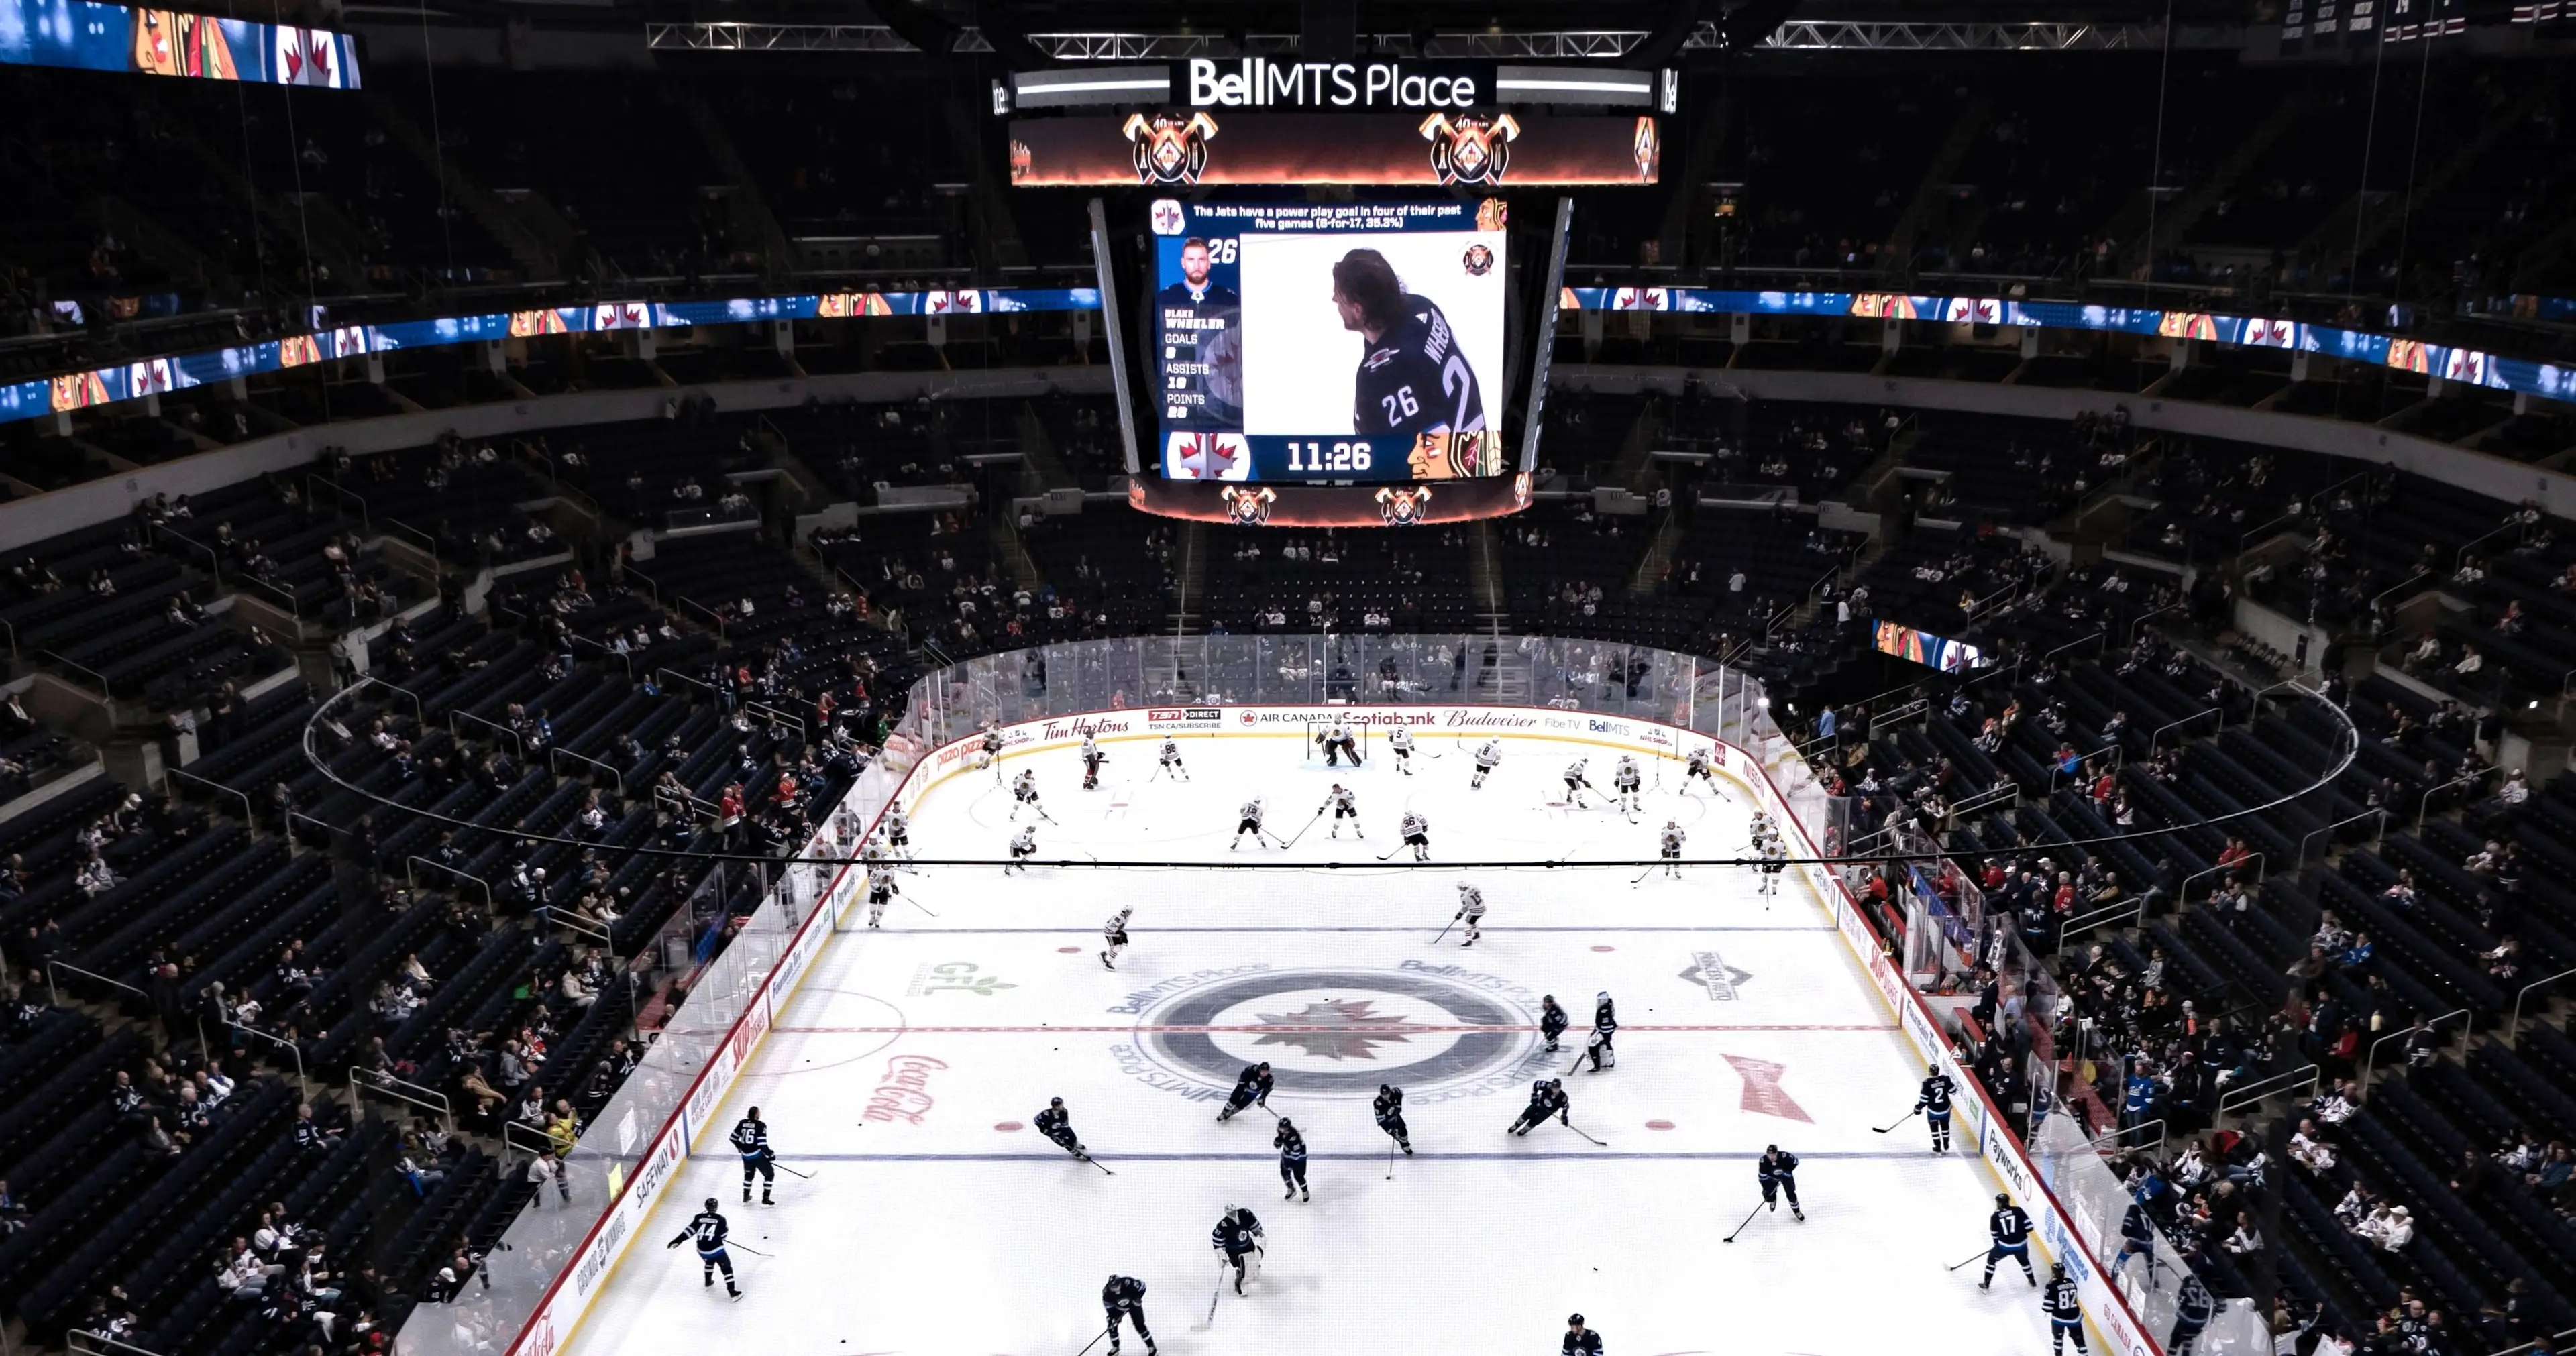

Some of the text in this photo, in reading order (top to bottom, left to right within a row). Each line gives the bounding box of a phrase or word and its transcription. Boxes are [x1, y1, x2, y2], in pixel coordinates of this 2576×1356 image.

[1191, 59, 1476, 105] BellMTS Place
[1194, 205, 1462, 219] The Jets have a power play goal in four of their past
[1255, 218, 1275, 229] five
[1277, 219, 1313, 231] games
[1208, 238, 1238, 264] 26
[1165, 309, 1194, 318] BLAKE
[1165, 318, 1224, 329] WHEELER
[1165, 333, 1198, 344] GOALS
[1166, 363, 1210, 374] ASSISTS
[1167, 394, 1205, 404] POINTS
[1382, 386, 1419, 428] 26
[1287, 442, 1371, 471] 11:26
[1151, 710, 1220, 720] TSN DIRECT
[1260, 713, 1332, 723] AIR CANADA
[1342, 712, 1436, 726] Scotiabank
[1443, 709, 1537, 728] Budweiser
[1043, 718, 1129, 740] Tim Hortons
[1545, 718, 1581, 730] Fibe TV
[1589, 719, 1630, 736] BellMTS
[1396, 728, 1403, 738] 5
[1165, 743, 1176, 754] 88
[1482, 746, 1490, 756] 8
[937, 746, 959, 771] pizza
[1403, 817, 1416, 828] 36
[1934, 1087, 1944, 1104] 2
[1988, 1128, 2023, 1191] Payworks
[635, 1147, 669, 1210] SAFEWAY
[696, 1223, 717, 1241] 44
[1999, 1214, 2016, 1236] 17
[2058, 1288, 2078, 1310] 82
